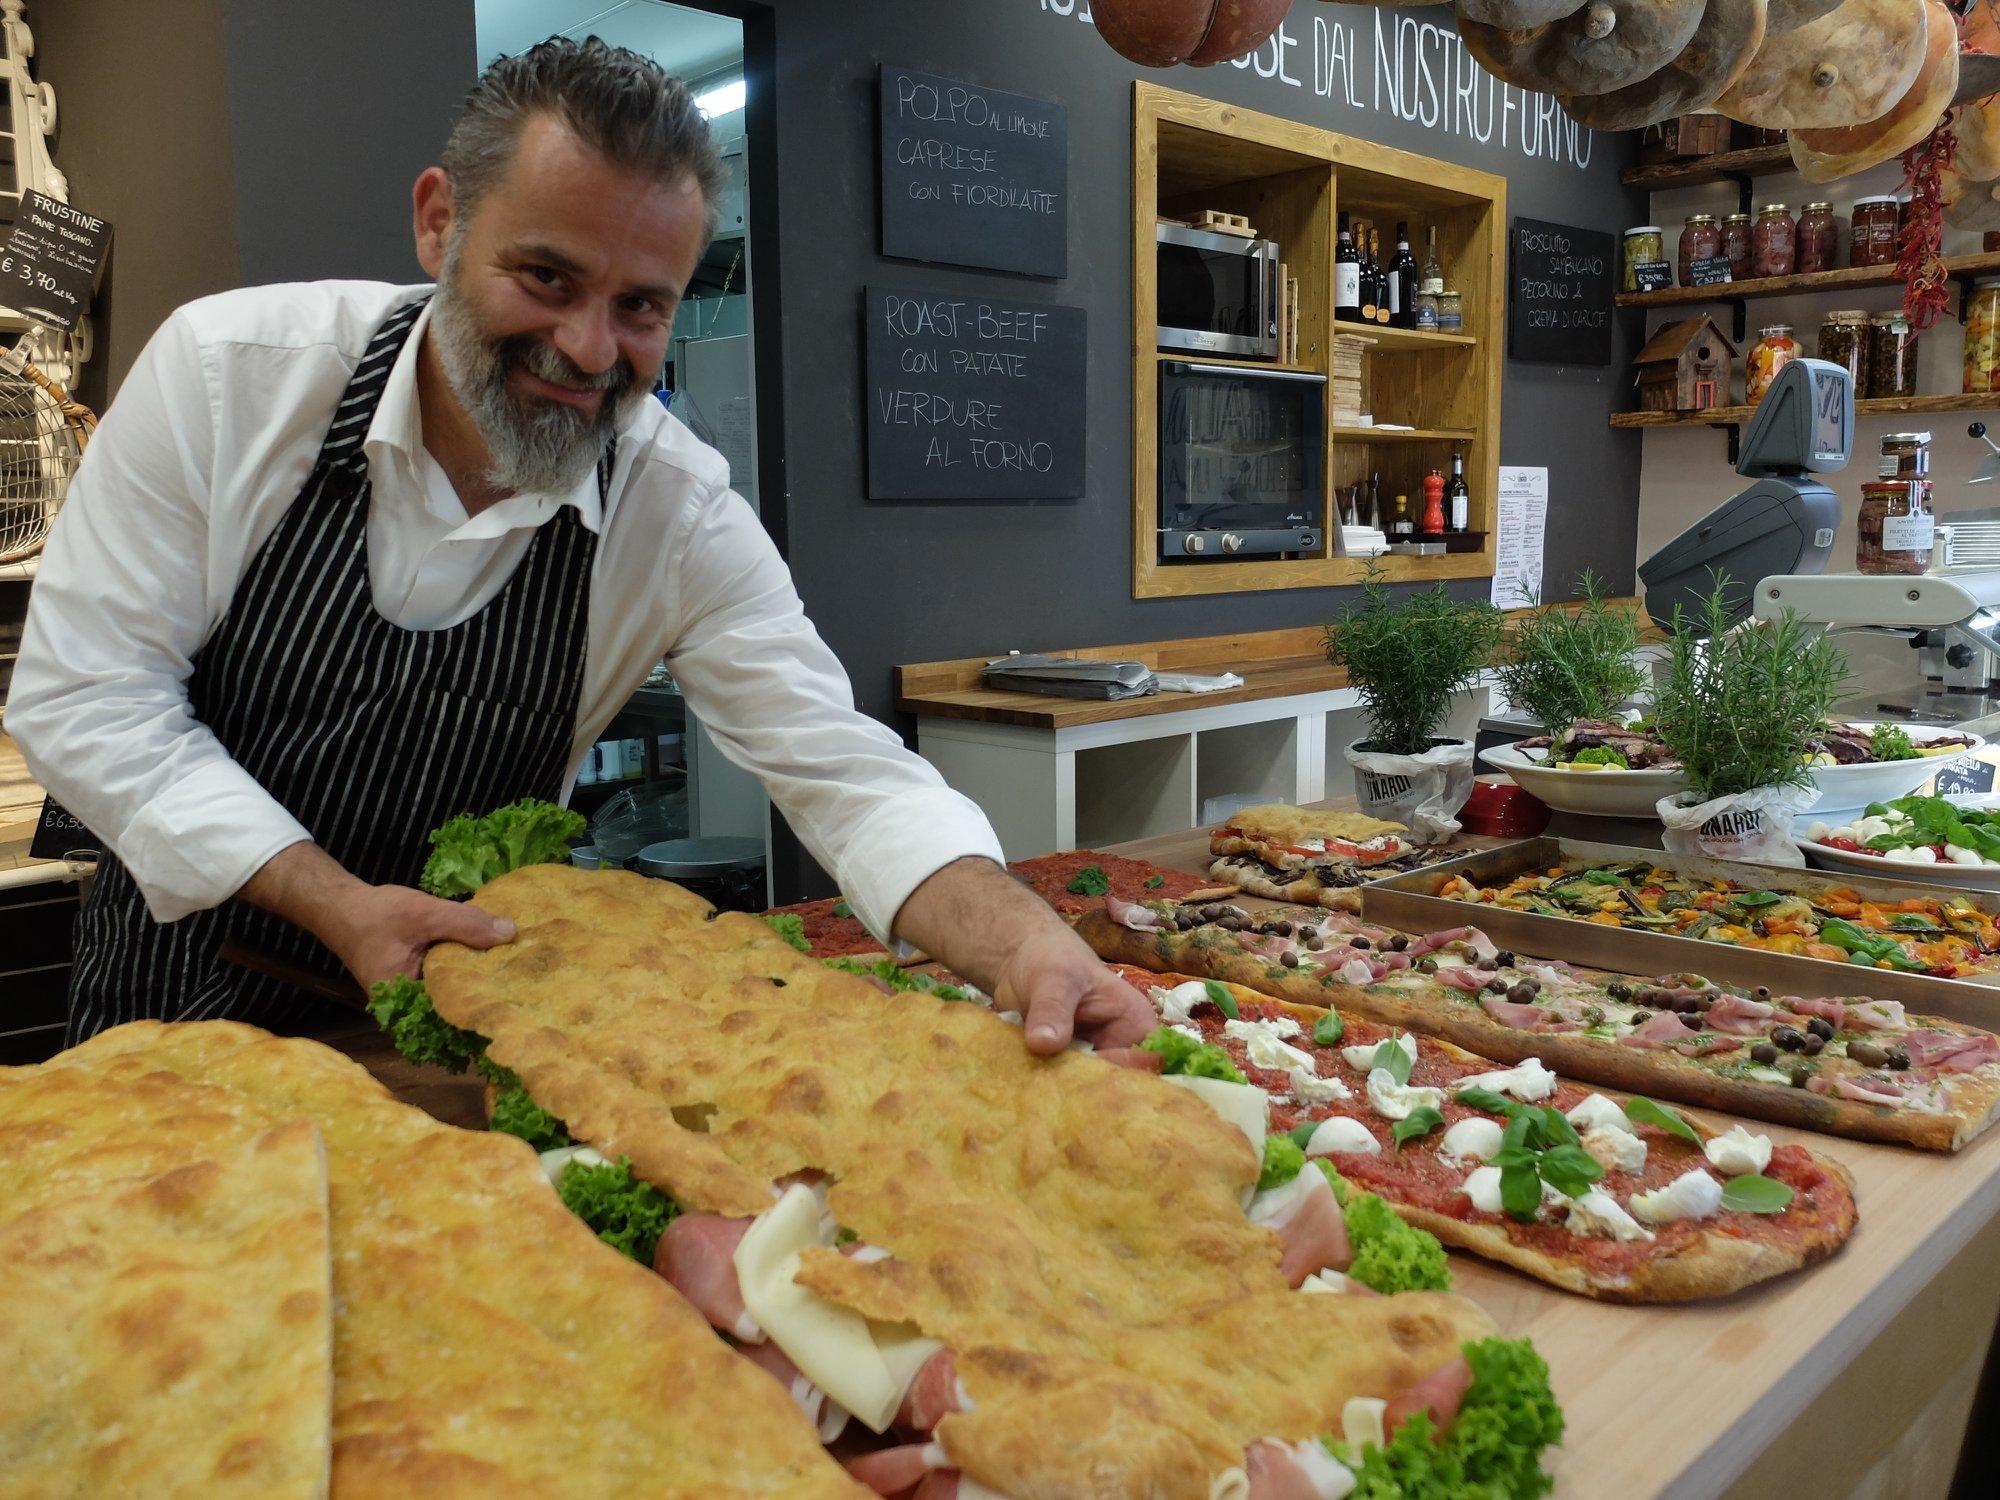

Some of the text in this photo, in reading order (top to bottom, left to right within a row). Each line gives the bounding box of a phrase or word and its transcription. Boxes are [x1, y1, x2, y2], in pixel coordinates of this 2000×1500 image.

[1314, 16, 1365, 108] DAL
[1374, 6, 1494, 144] NOSTRO
[897, 75, 1051, 139] POLPO AL LIMONE
[897, 137, 998, 173] CAPRESE
[908, 181, 940, 201] CON
[31, 214, 55, 232] PANE
[33, 193, 104, 234] FRUSTINE
[2, 257, 14, 273] €
[19, 264, 57, 291] 3,70
[885, 295, 1049, 343] ROAST-BEEF
[901, 348, 1028, 378] CON PATATE
[879, 387, 1003, 431] VERDURE
[925, 436, 1053, 473] AL FORNO
